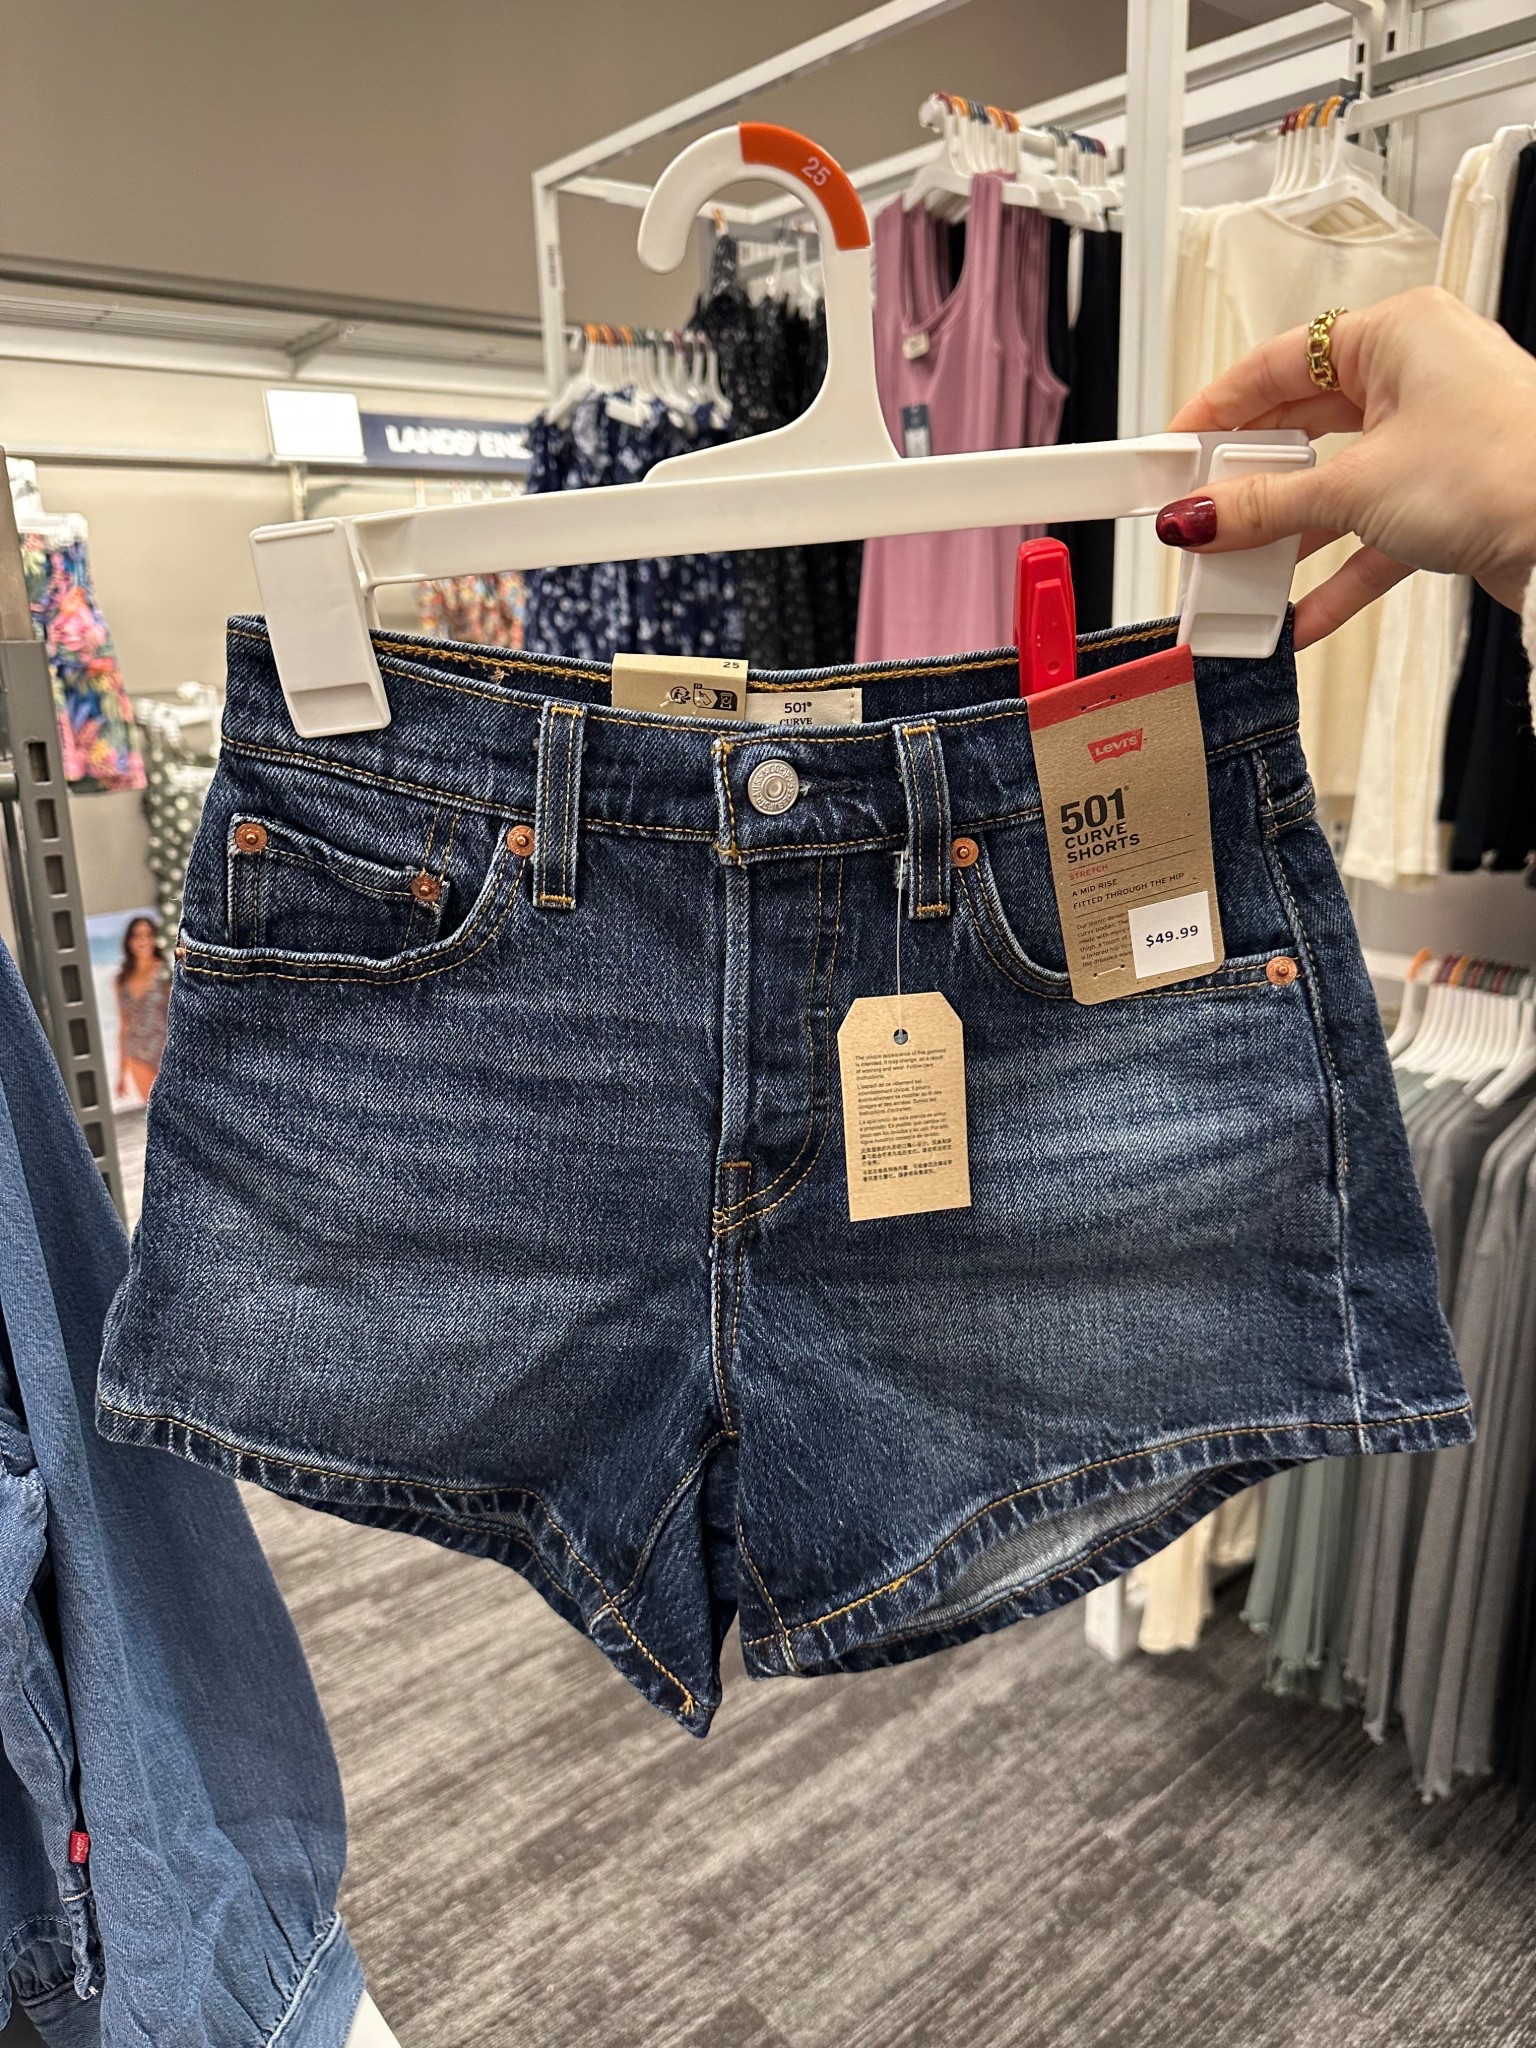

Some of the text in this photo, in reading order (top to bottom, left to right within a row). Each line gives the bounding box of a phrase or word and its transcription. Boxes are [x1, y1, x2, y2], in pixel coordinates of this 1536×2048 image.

[801, 156, 832, 187] 25
[722, 661, 740, 669] 25
[780, 717, 813, 725] CURVE
[1065, 822, 1127, 849] CURVE
[1067, 834, 1140, 863] SHORTS
[1069, 864, 1109, 881] STRETCH
[1071, 878, 1118, 898] A MID RISE
[1073, 872, 1185, 910] FITTED THROUGH THE HIP
[1145, 925, 1199, 948] $49.99
